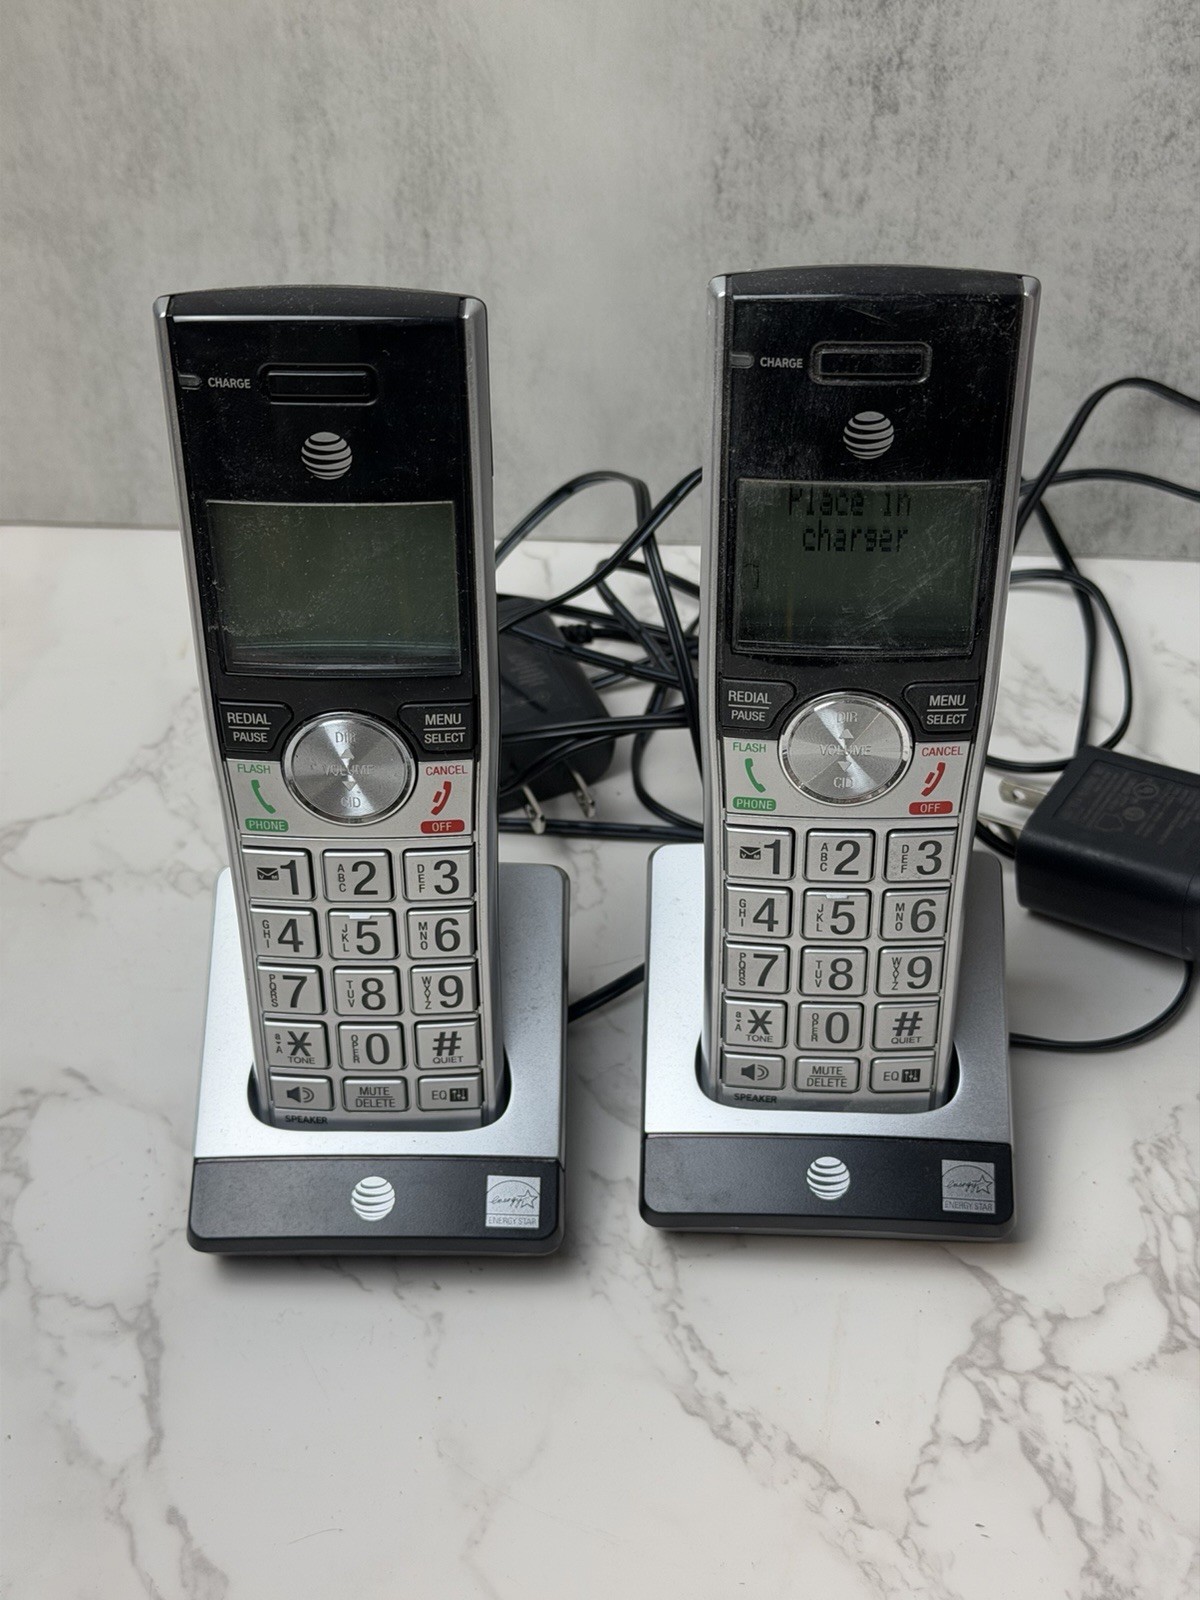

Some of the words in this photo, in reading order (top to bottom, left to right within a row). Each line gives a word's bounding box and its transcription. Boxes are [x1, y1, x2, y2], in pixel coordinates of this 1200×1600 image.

[760, 357, 803, 369] CHARGE
[208, 377, 250, 388] CHARGE
[789, 484, 865, 516] Place
[802, 519, 908, 552] charger
[728, 690, 772, 704] REDIAL
[929, 694, 966, 707] MENU
[227, 712, 271, 725] REDIAL
[425, 713, 461, 725] MENU
[731, 710, 765, 722] PAUSE
[837, 711, 857, 723] DIR
[926, 714, 966, 725] SELECT
[233, 731, 268, 742] PAUSE
[424, 732, 465, 744] SELECT
[733, 742, 766, 753] FLASH
[819, 744, 872, 756] VOLUME
[922, 746, 963, 757] CANCEL
[237, 764, 271, 774] FLASH
[426, 765, 467, 776] CANCEL
[833, 776, 855, 788] CID
[736, 799, 773, 810] PHONE
[920, 803, 941, 813] OFF
[249, 820, 285, 831] PHONE
[432, 822, 452, 832] OFF
[764, 839, 781, 875] 1
[834, 840, 861, 875] 2
[916, 840, 942, 875] 3
[280, 860, 299, 895] 1
[351, 861, 378, 895] 2
[433, 860, 460, 895] 3
[752, 897, 778, 932] 4
[830, 901, 855, 935] 5
[910, 899, 936, 933] 6
[277, 918, 303, 953] 4
[356, 920, 381, 955] 5
[434, 917, 461, 952] 6
[752, 953, 779, 987] 7
[828, 957, 853, 991] 8
[906, 956, 932, 989] 9
[282, 975, 308, 1008] 7
[361, 977, 386, 1011] 8
[438, 975, 464, 1008] 9
[824, 1011, 849, 1043] 0
[892, 1011, 923, 1036] #
[432, 1031, 462, 1057] #
[746, 1034, 773, 1043] TONE
[890, 1036, 922, 1044] QUIET
[365, 1033, 390, 1065] 0
[287, 1056, 315, 1065] TONE
[432, 1056, 463, 1064] QUIET
[812, 1065, 843, 1075] MUTE
[883, 1071, 899, 1081] EQ
[806, 1077, 848, 1088] DELETE
[359, 1086, 390, 1096] MUTE
[432, 1090, 447, 1101] EQ
[356, 1099, 396, 1108] DELETE
[734, 1093, 777, 1104] SPEAKER
[285, 1115, 328, 1125] SPEAKER
[945, 1201, 972, 1210] ENERGY
[974, 1202, 993, 1211] STAR
[488, 1216, 516, 1225] ENERGY
[518, 1217, 536, 1226] STAR
